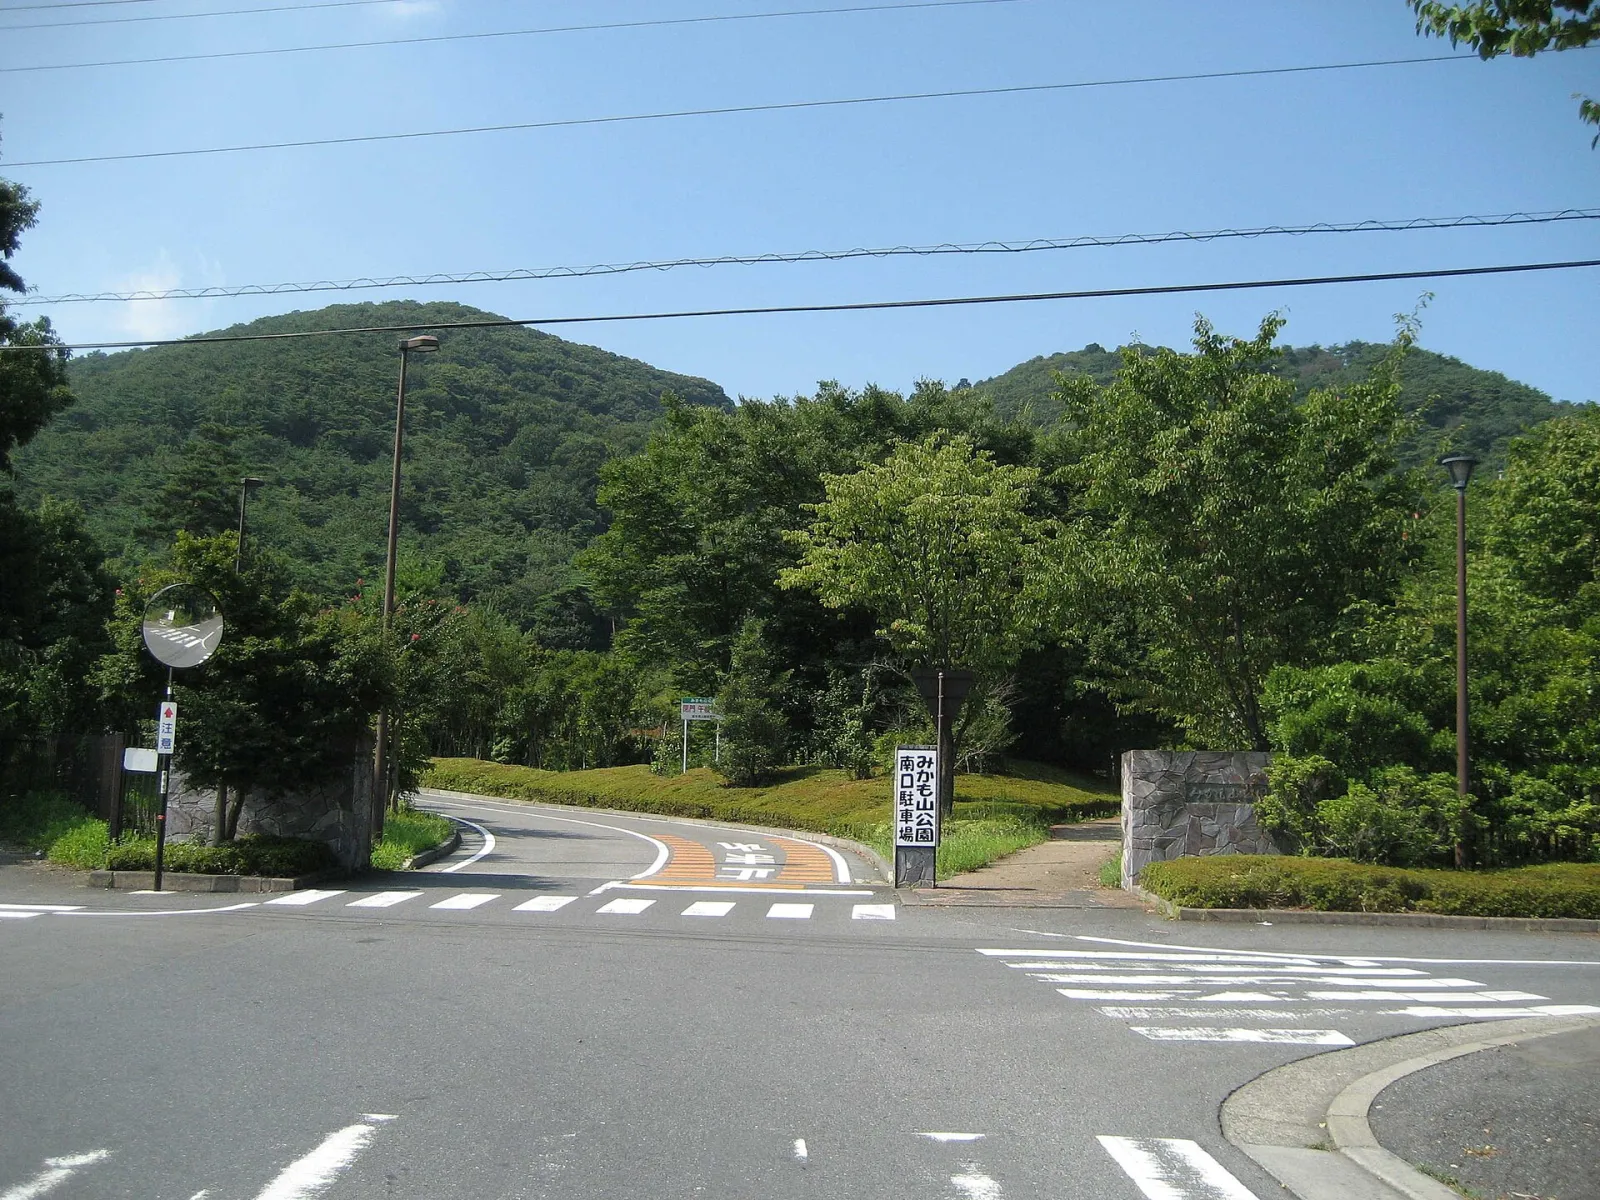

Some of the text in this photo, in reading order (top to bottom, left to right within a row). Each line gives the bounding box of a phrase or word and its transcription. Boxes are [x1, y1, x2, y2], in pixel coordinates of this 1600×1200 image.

[160, 722, 173, 750] 注意
[899, 755, 915, 843] 南口駐車場
[915, 755, 934, 843] みかも山公園
[715, 842, 776, 880] 止まれ
